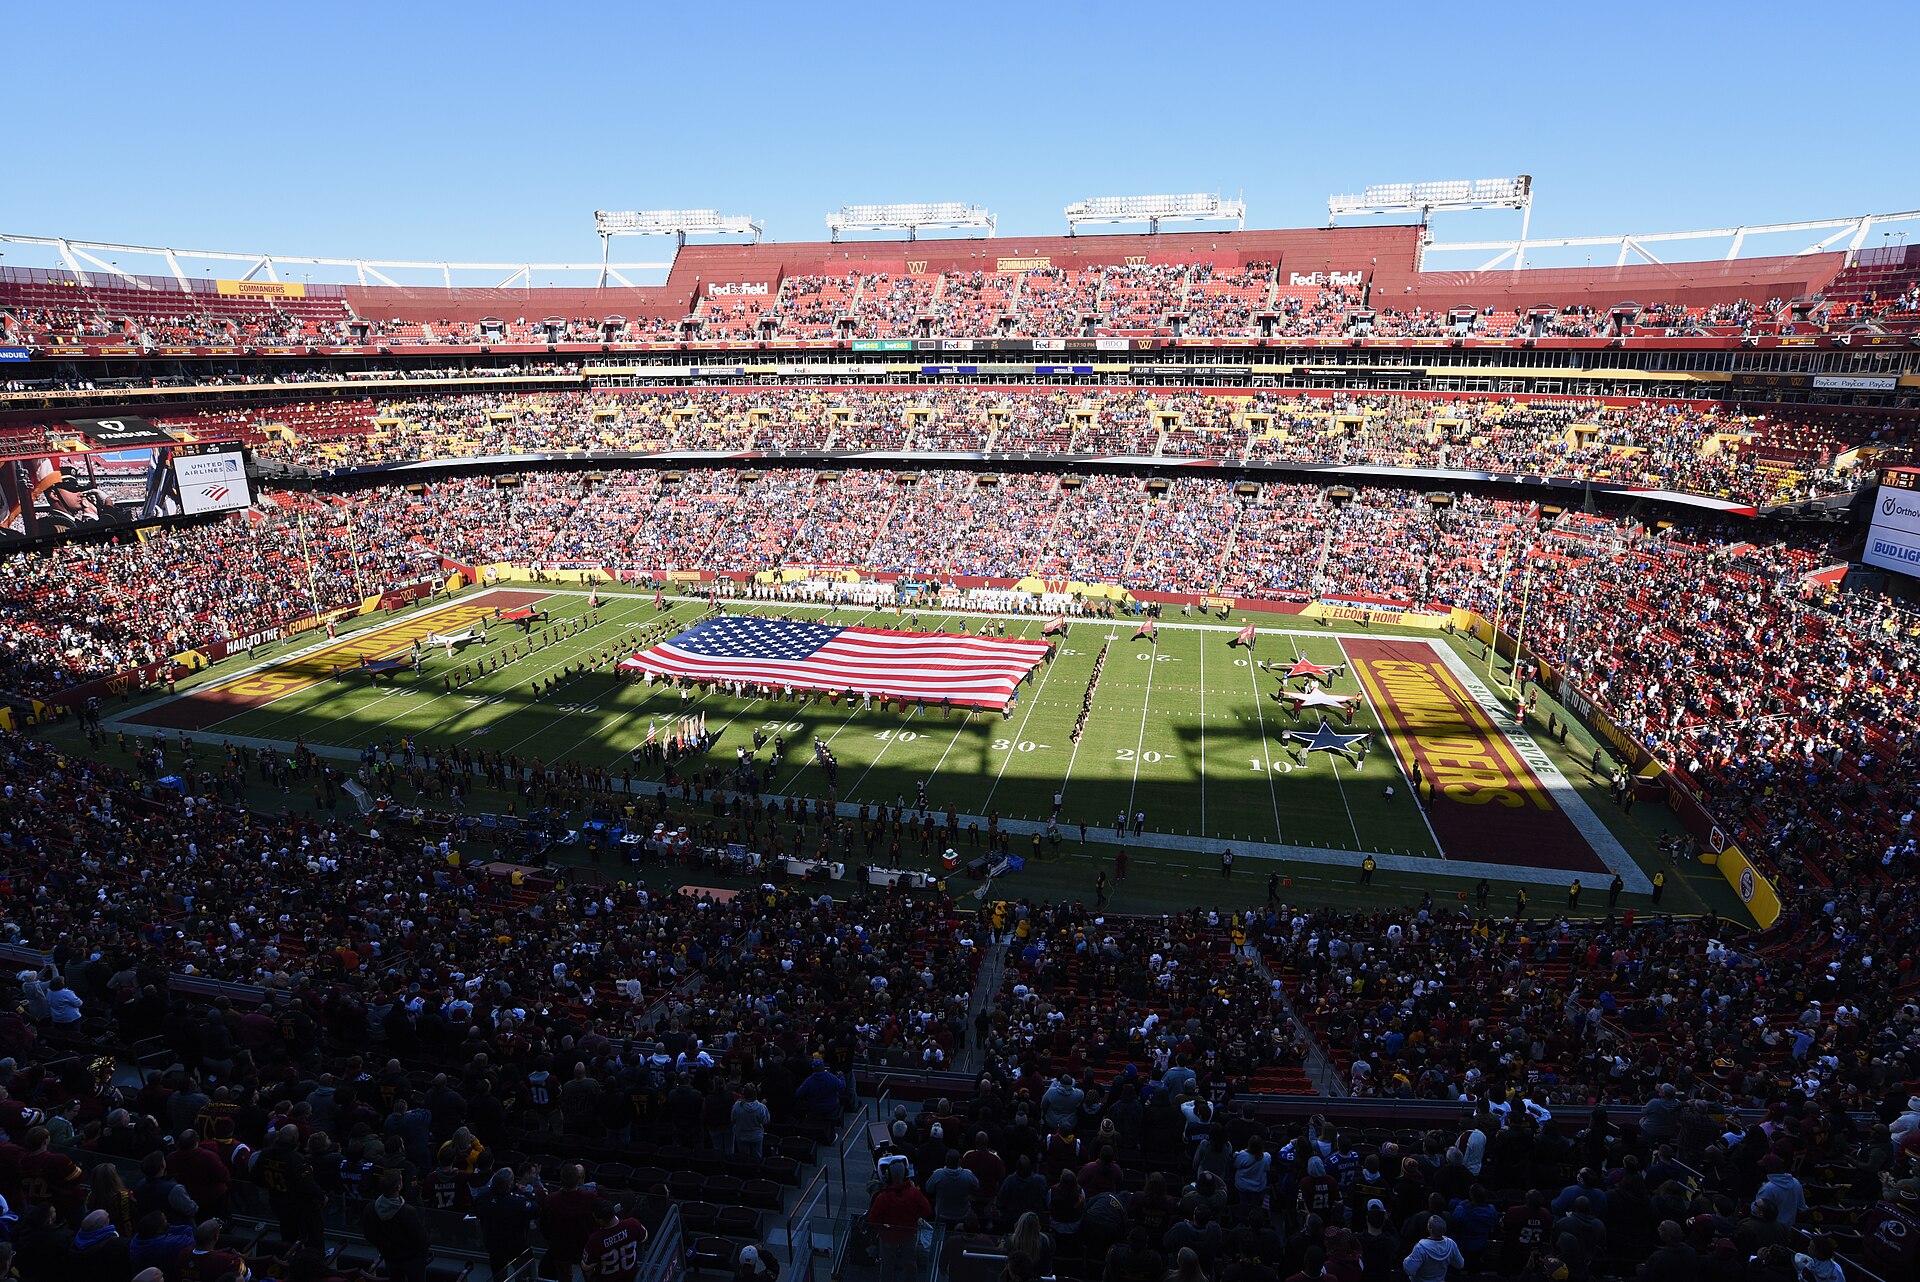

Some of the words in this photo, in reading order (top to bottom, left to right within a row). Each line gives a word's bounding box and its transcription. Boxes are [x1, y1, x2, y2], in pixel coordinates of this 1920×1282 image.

[997, 259, 1050, 270] COMMANDERS
[1290, 271, 1362, 286] FedExField
[238, 285, 285, 294] COMMANDERS
[709, 282, 768, 295] FedExField
[944, 341, 968, 349] FedEx
[1815, 379, 1838, 387] Paycor
[1842, 380, 1866, 388] Paycor
[97, 430, 158, 440] FANDUEL
[184, 468, 224, 476] AIRLINES
[191, 462, 222, 470] UNITED
[1874, 542, 1897, 556] BUD
[400, 588, 414, 600] W
[1043, 580, 1068, 594] W
[1373, 612, 1402, 624] HOME
[226, 638, 250, 655] HAIL
[250, 633, 261, 646] TO
[261, 627, 279, 642] THE
[762, 720, 804, 732] 50
[1570, 691, 1580, 708] TO
[1579, 696, 1592, 717] THE
[1596, 713, 1639, 764] COMMANDERS
[873, 729, 916, 742] 40
[1371, 660, 1525, 808] COMMANDERS
[991, 739, 1036, 752] 30
[1505, 729, 1556, 774] SERVICE
[1115, 748, 1162, 762] 20
[1249, 759, 1293, 773] 10
[1711, 831, 1722, 849] 25
[435, 1191, 456, 1208] 17
[1313, 1194, 1329, 1208] 21
[604, 1229, 628, 1248] GREEN
[600, 1240, 637, 1276] 28
